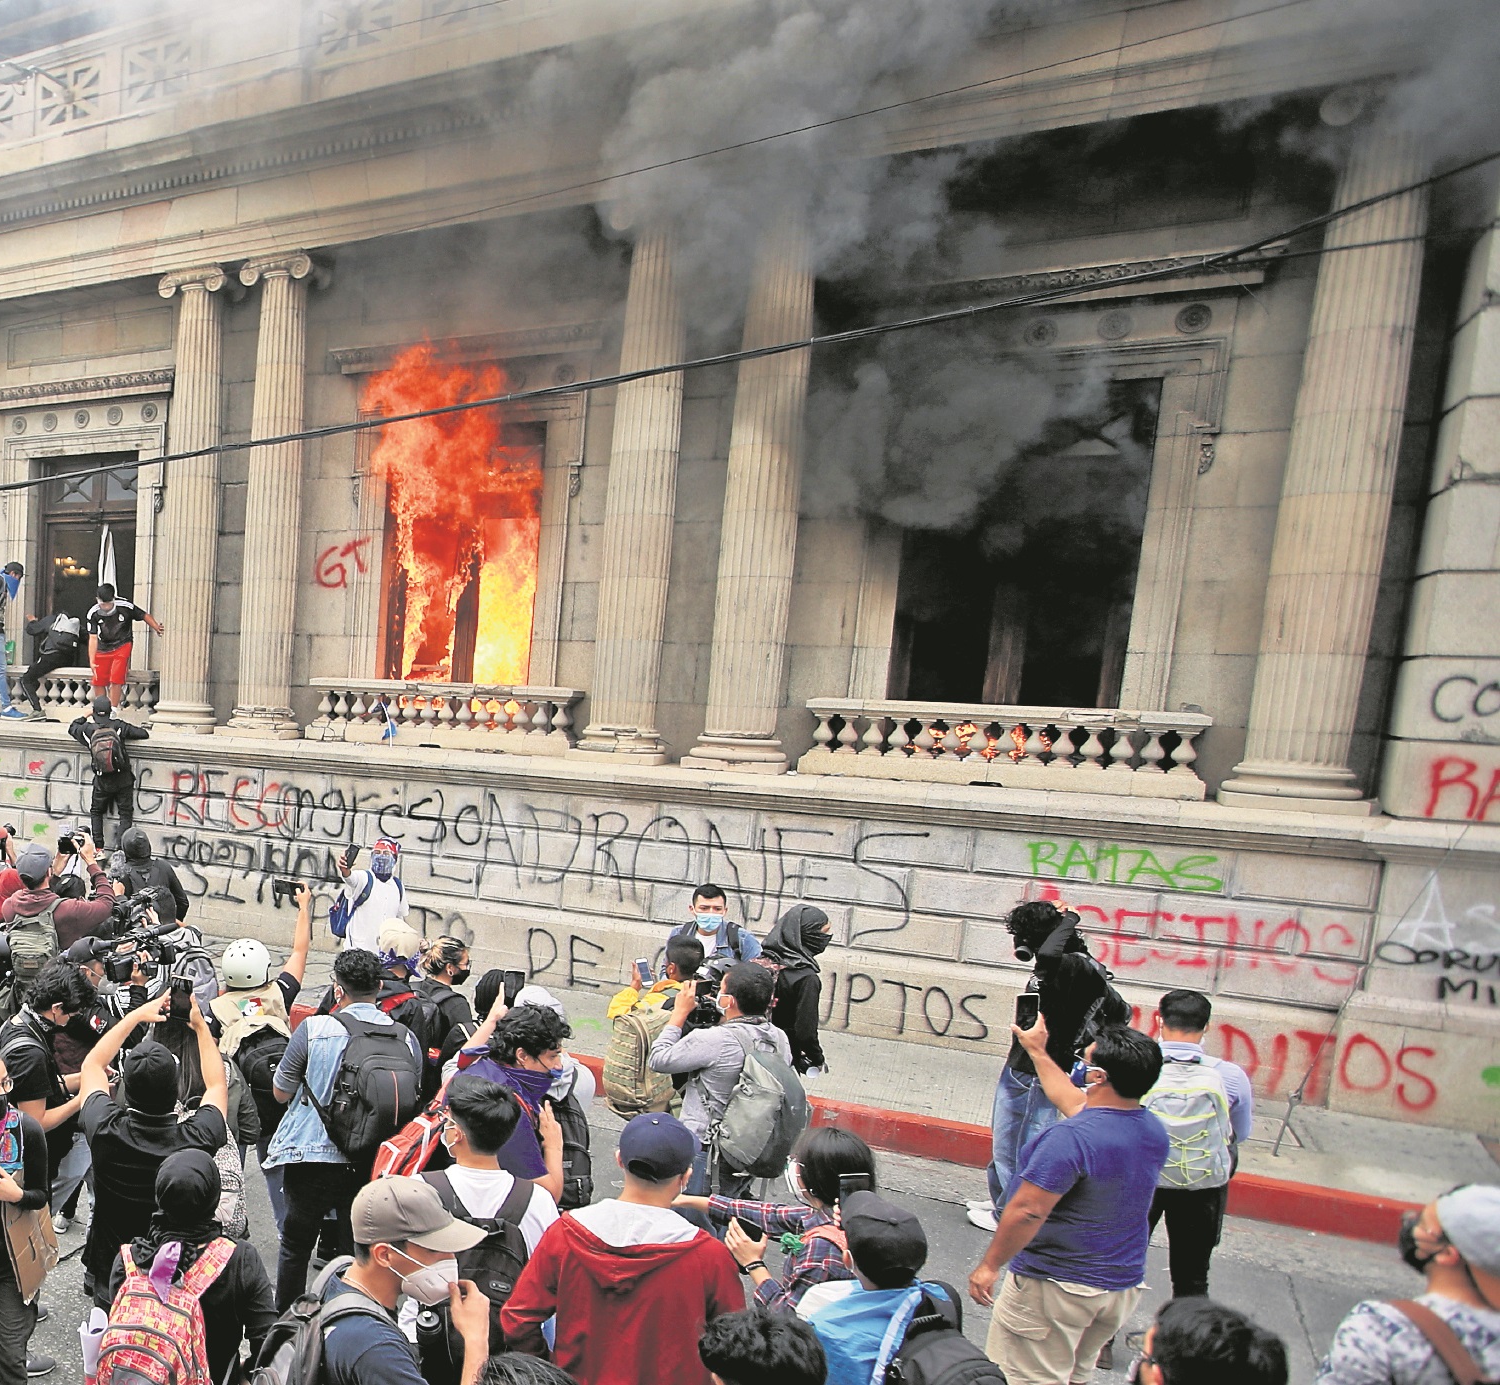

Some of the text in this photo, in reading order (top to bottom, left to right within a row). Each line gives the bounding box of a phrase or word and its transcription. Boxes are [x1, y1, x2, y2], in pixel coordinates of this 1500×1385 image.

[314, 536, 372, 588] GT
[1028, 840, 1223, 892] RATAS
[526, 927, 605, 989] DE
